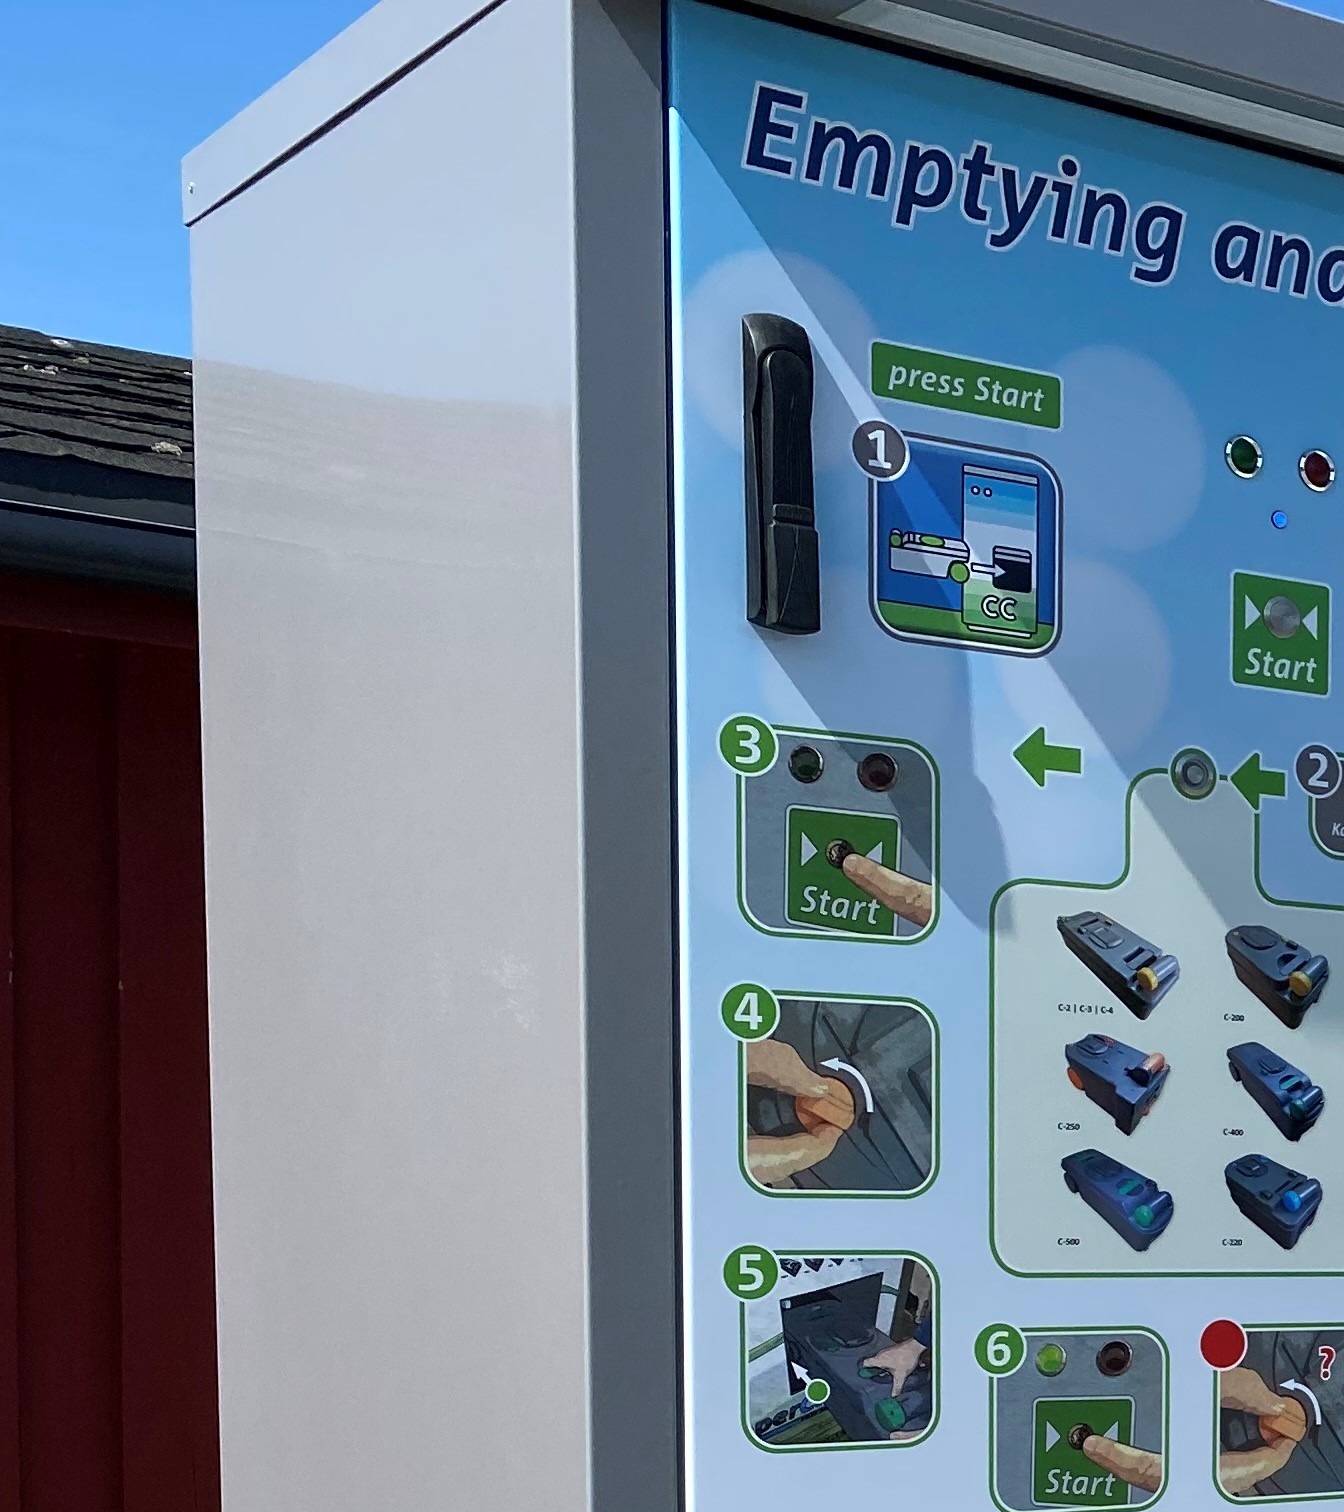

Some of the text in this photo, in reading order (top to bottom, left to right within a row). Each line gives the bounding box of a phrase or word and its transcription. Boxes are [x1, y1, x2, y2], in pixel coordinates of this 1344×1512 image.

[743, 85, 1185, 285] Emptying
[888, 361, 1046, 413] press Start
[866, 429, 892, 470] 1
[980, 596, 1018, 622] CC
[1244, 647, 1318, 684] Start
[735, 724, 761, 765] 3
[1307, 752, 1329, 788] 2
[800, 885, 881, 925] Start
[734, 992, 763, 1031] 4
[1058, 1004, 1071, 1013] C-2
[1079, 1004, 1092, 1013] C-3
[1100, 1005, 1114, 1015] C-4
[737, 1253, 764, 1292] 5
[985, 1331, 1012, 1368] 6
[1317, 1346, 1336, 1380] ?
[1044, 1466, 1117, 1499] Start
